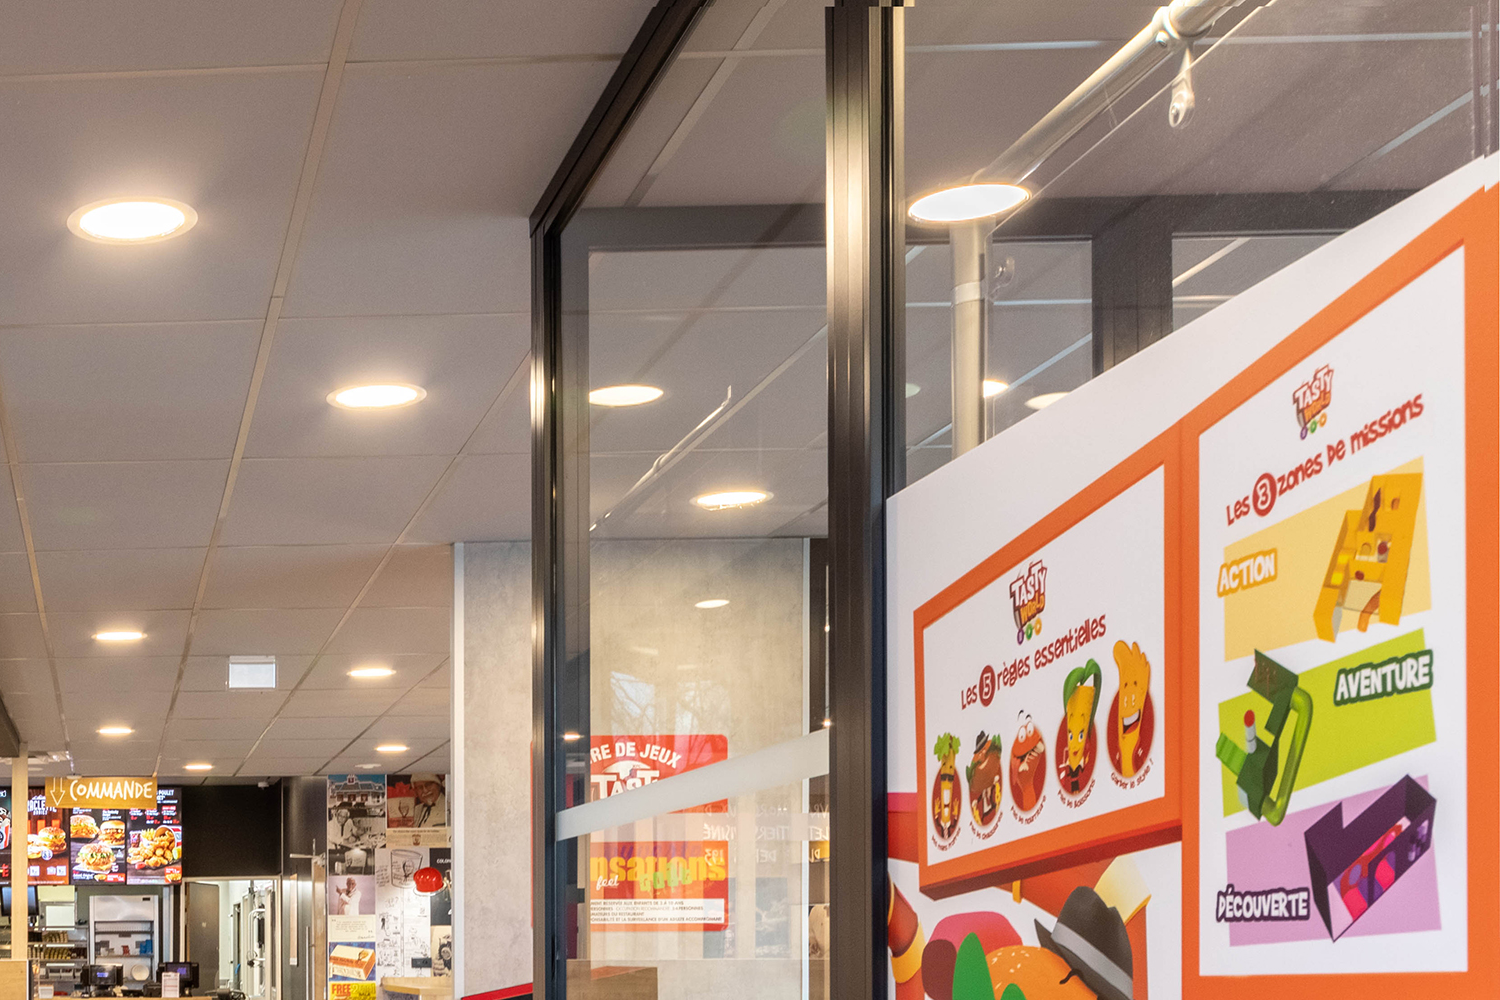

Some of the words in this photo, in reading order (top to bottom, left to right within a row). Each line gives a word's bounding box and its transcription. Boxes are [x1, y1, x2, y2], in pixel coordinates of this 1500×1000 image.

[1293, 364, 1334, 409] TASTY
[1227, 495, 1249, 526] Les
[1277, 453, 1322, 497] zones
[1351, 394, 1424, 455] missions
[1010, 561, 1047, 606] TASTY
[1218, 552, 1275, 593] ACTION
[1020, 593, 1045, 624] WORLD
[961, 684, 977, 710] Les
[997, 655, 1030, 691] règles
[1034, 614, 1106, 669] essentielles
[1336, 655, 1430, 701] AVENTURE
[615, 742, 635, 757] DE
[640, 744, 681, 769] JEUX
[70, 780, 153, 801] COMMANDE
[596, 875, 619, 890] feel
[1218, 887, 1308, 918] DÉCOUVERTE
